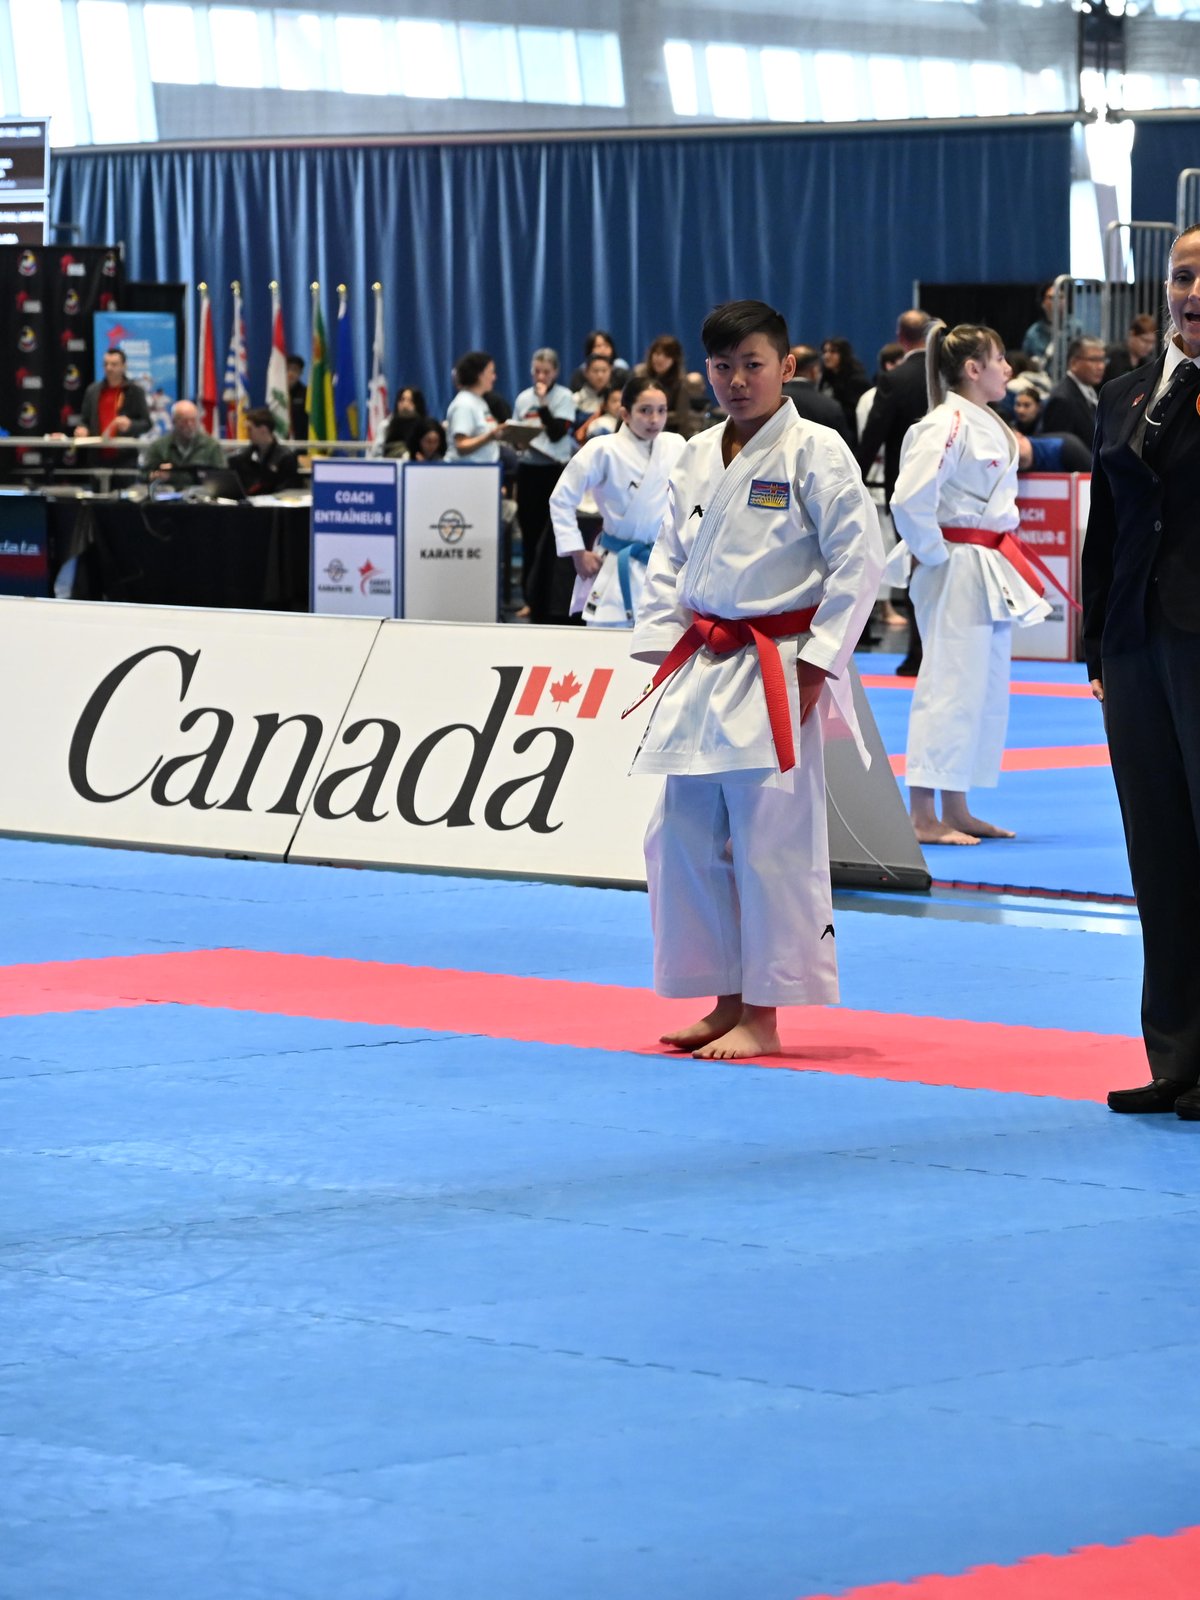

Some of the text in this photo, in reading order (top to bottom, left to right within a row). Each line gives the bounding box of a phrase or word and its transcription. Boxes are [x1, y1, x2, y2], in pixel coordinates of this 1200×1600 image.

[335, 490, 374, 503] COACH
[1020, 508, 1046, 522] ACH
[420, 549, 481, 559] KARATE BC
[68, 645, 575, 834] Canada
